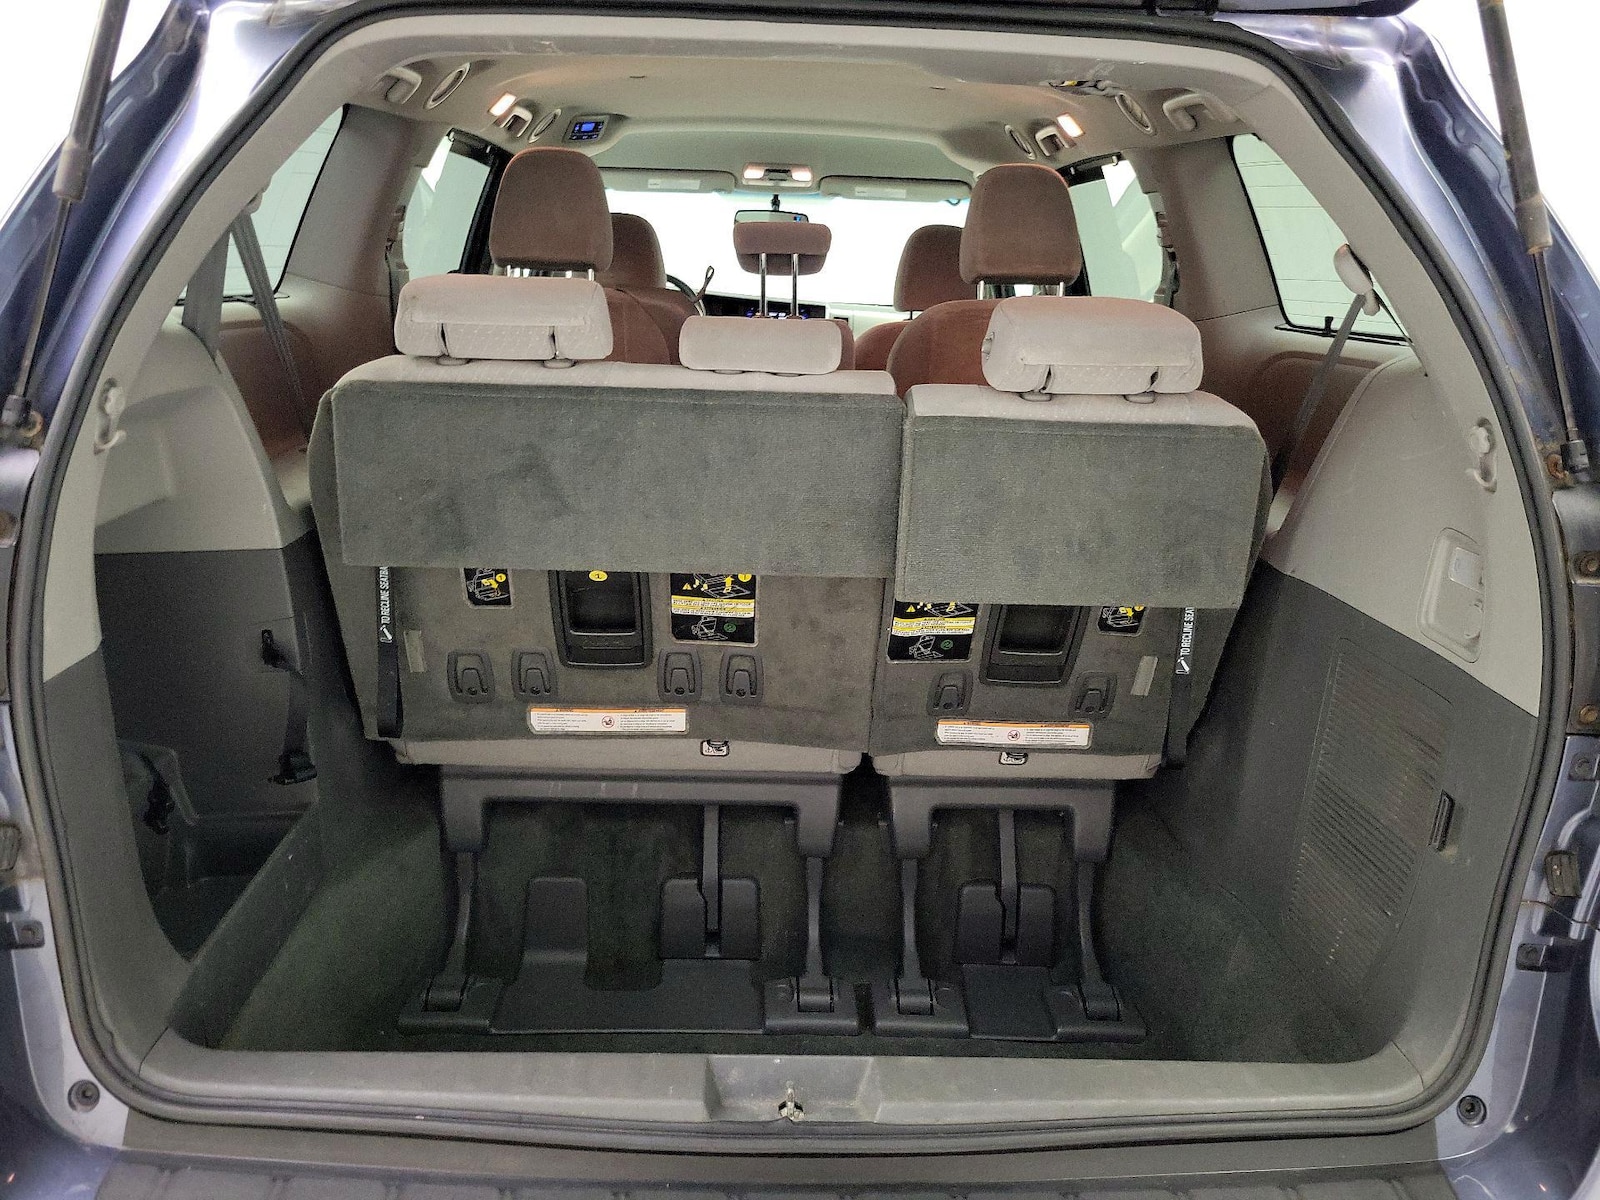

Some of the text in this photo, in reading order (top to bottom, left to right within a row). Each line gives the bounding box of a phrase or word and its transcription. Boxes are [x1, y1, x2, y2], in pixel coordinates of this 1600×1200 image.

[380, 590, 390, 616] RECLINE
[380, 615, 390, 624] TO
[1181, 622, 1193, 647] RECLINE
[1180, 647, 1190, 656] TO
